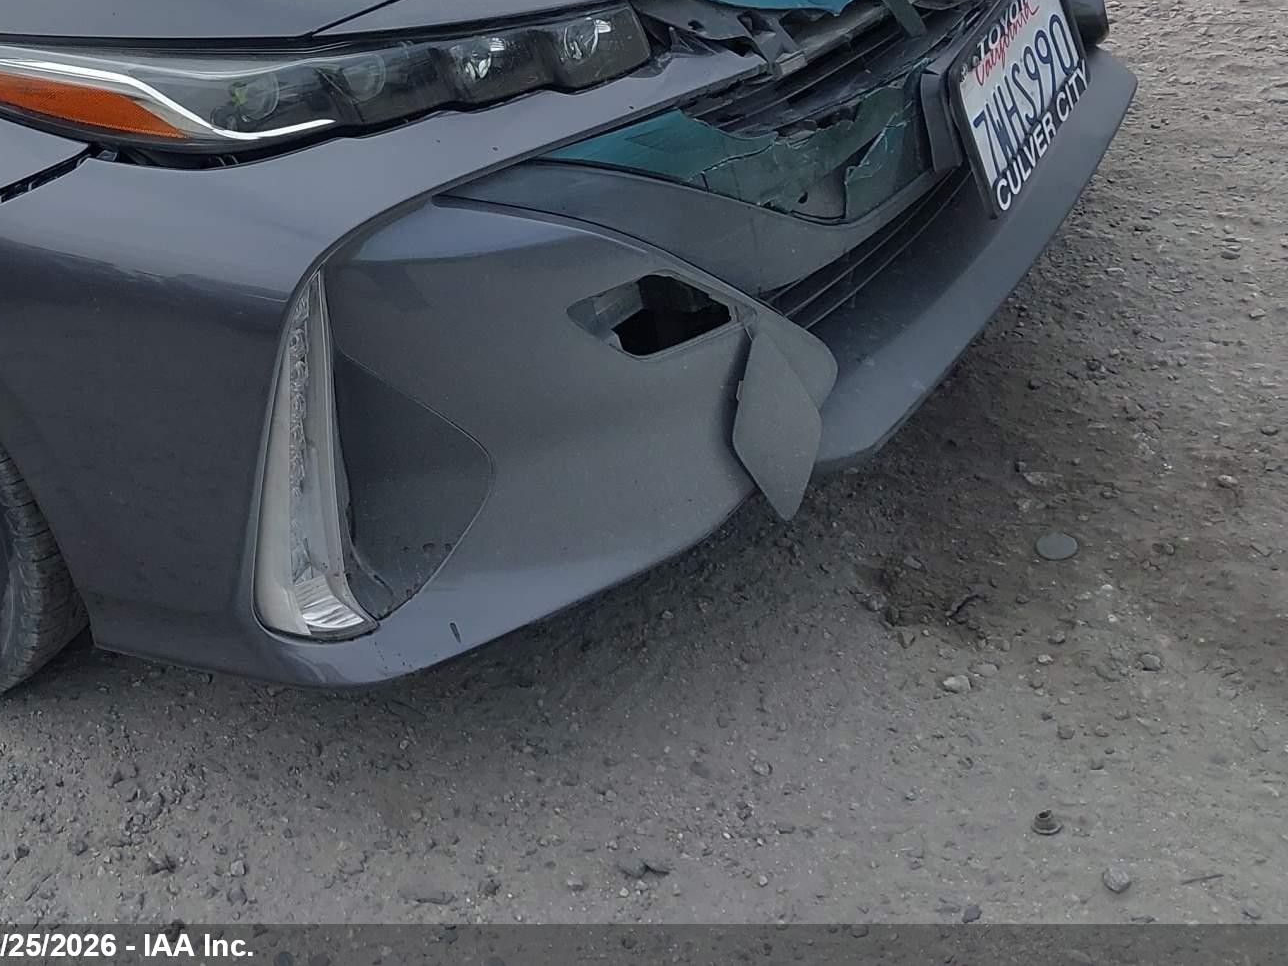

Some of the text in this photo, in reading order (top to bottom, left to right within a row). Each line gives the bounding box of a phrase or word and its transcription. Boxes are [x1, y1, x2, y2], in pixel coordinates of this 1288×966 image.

[973, 14, 1079, 176] 7WHS990
[996, 59, 1088, 211] CULVER CITY
